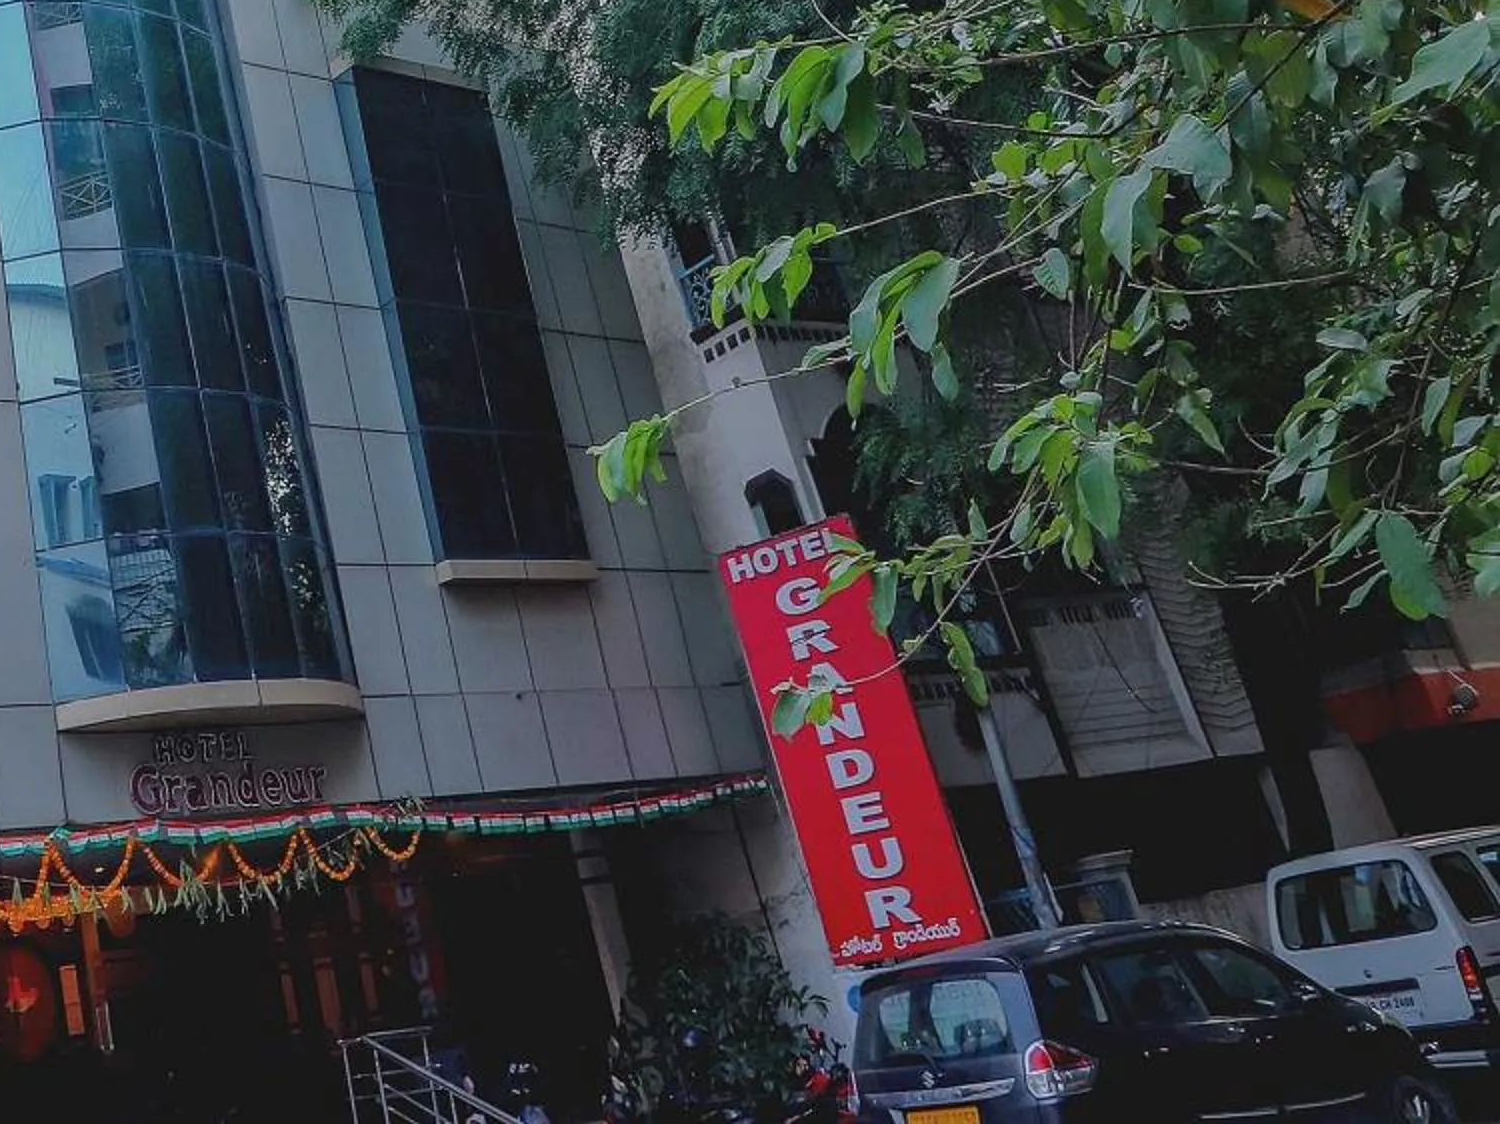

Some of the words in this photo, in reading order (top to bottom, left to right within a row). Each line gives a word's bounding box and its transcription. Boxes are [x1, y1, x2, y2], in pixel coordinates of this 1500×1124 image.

[155, 731, 254, 766] HOTEL
[775, 576, 922, 929] GRANDEUR
[129, 760, 328, 816] Grandeur
